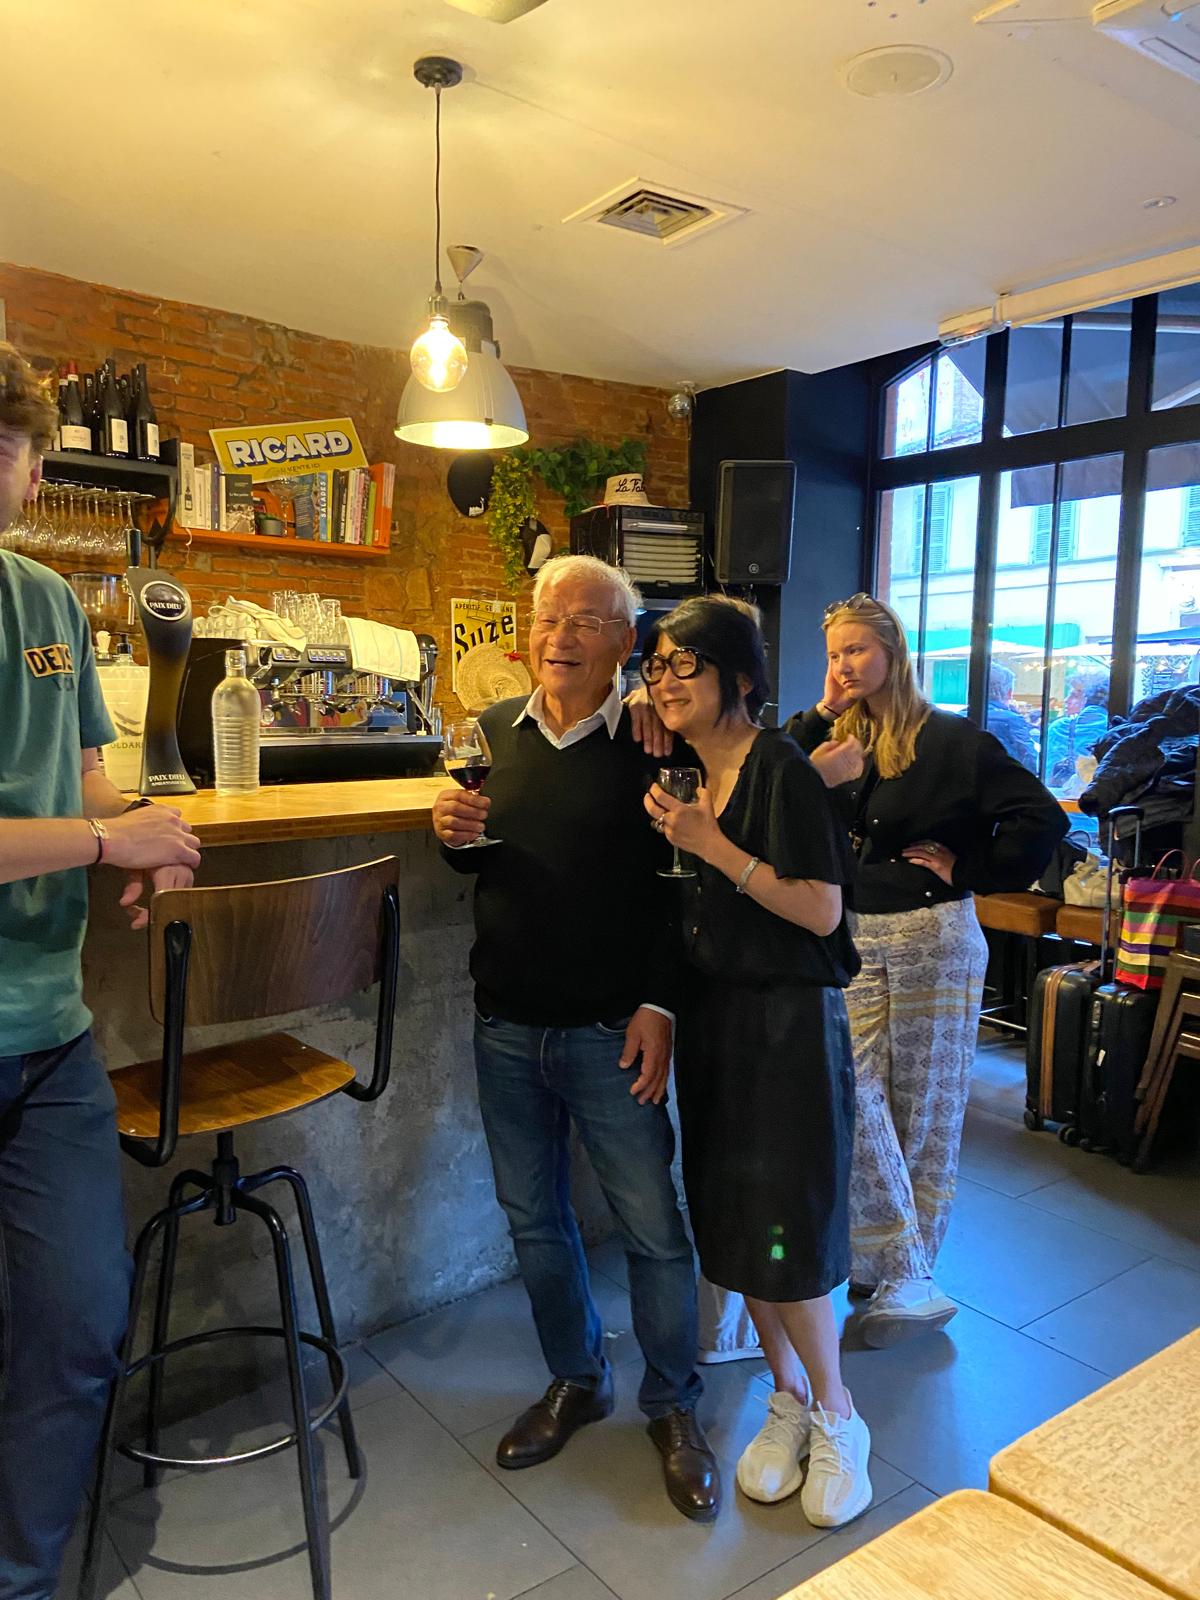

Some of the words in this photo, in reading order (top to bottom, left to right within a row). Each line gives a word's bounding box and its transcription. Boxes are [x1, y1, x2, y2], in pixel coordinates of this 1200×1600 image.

[226, 431, 352, 468] RICARD
[615, 478, 630, 493] La
[149, 602, 166, 610] PAIX
[166, 602, 182, 610] DIEU
[485, 604, 513, 613] GEANE
[148, 774, 168, 782] PAIX
[168, 773, 186, 781] DIEU
